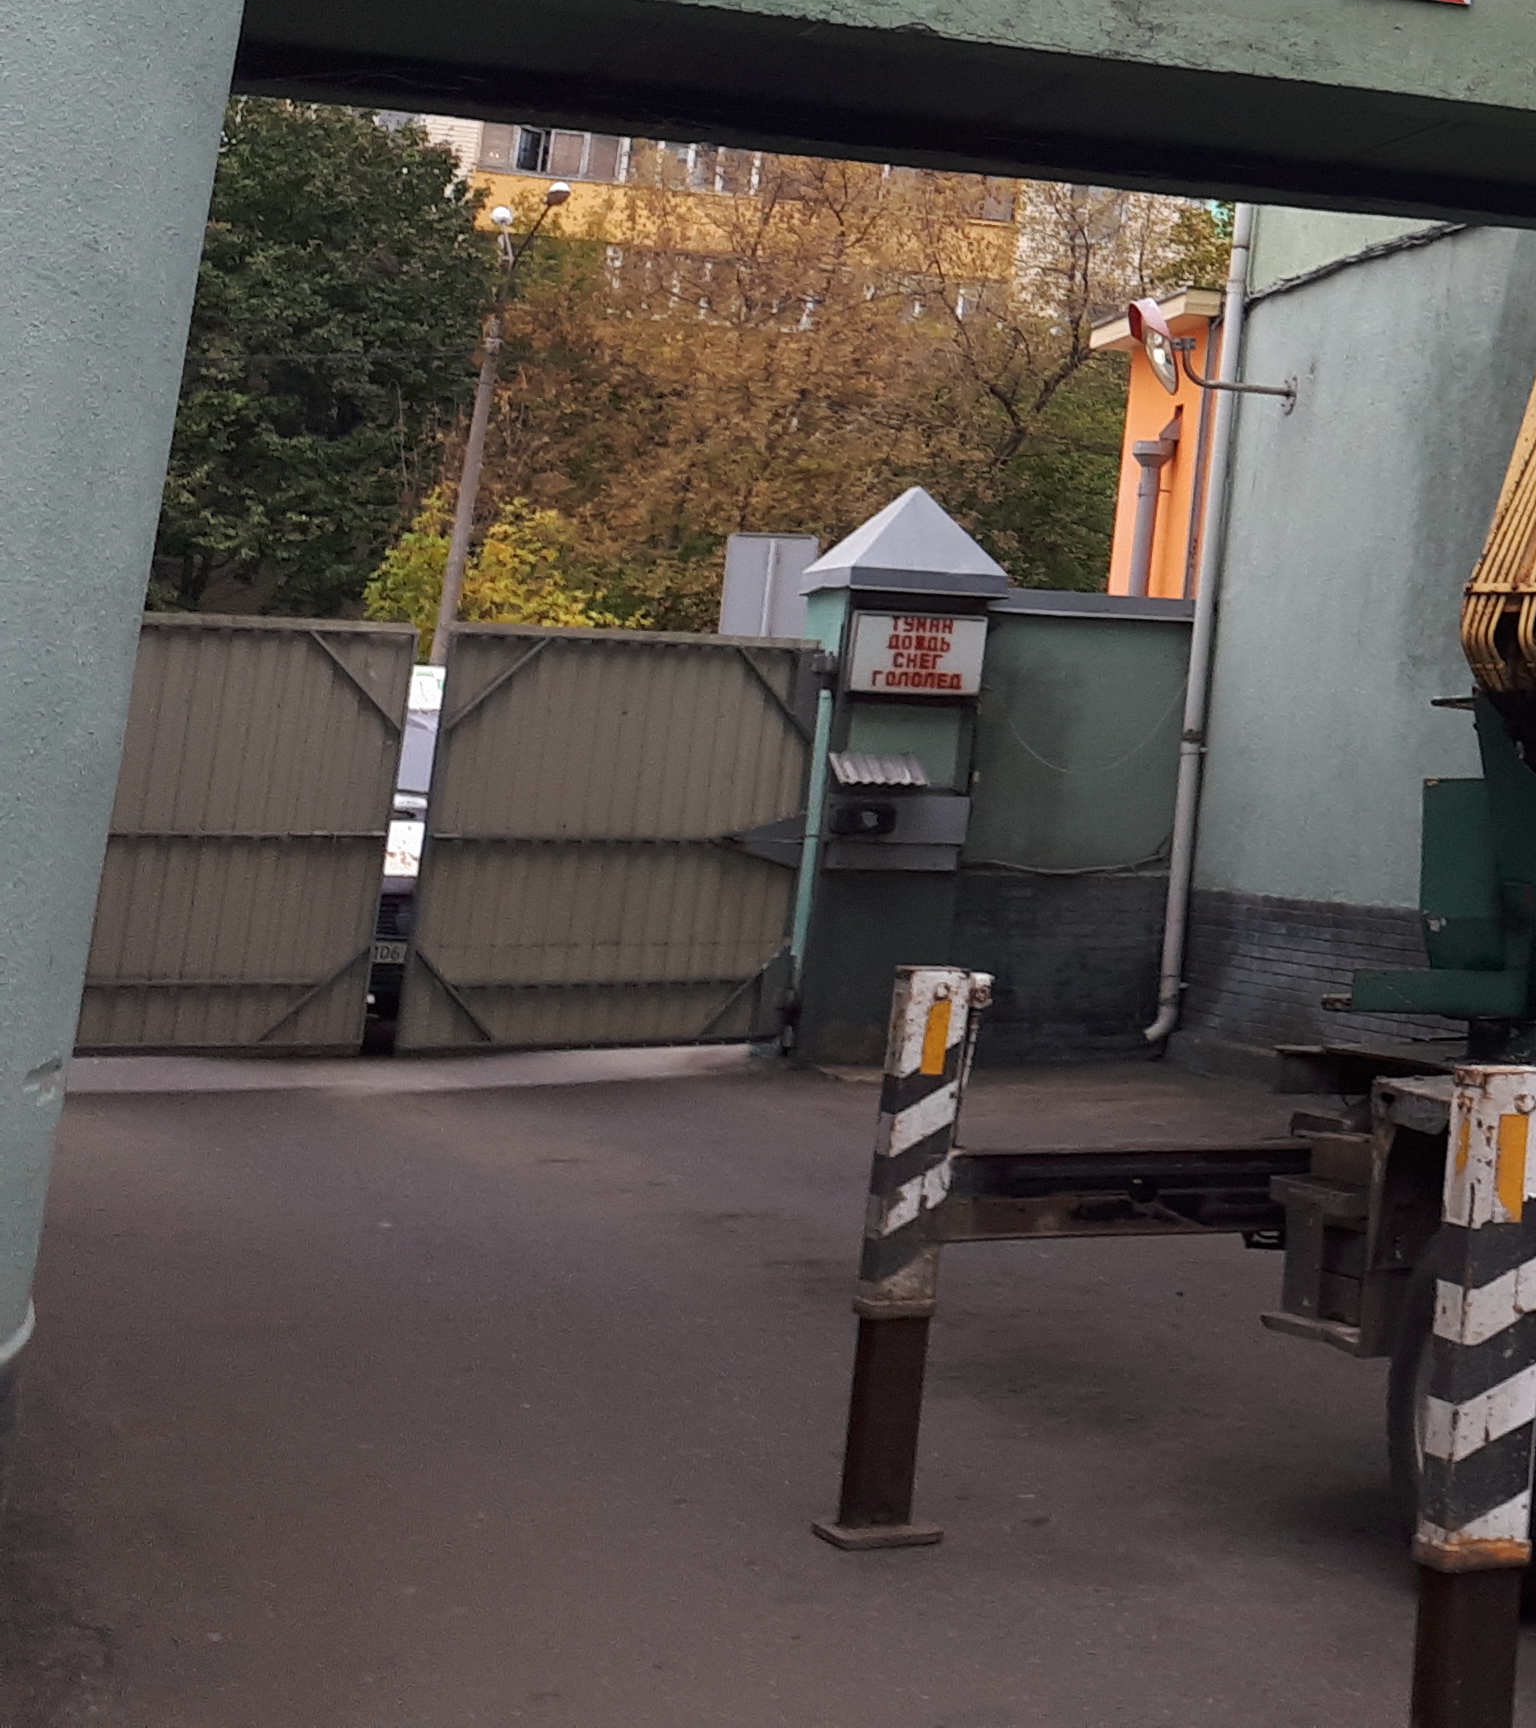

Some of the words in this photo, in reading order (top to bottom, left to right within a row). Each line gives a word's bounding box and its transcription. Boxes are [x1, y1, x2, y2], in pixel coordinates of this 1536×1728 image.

[891, 615, 954, 635] ТУМАН
[887, 633, 951, 653] ДОЖДЬ
[892, 652, 944, 670] СНЕГ
[871, 670, 963, 690] ГОЛОЛЕД
